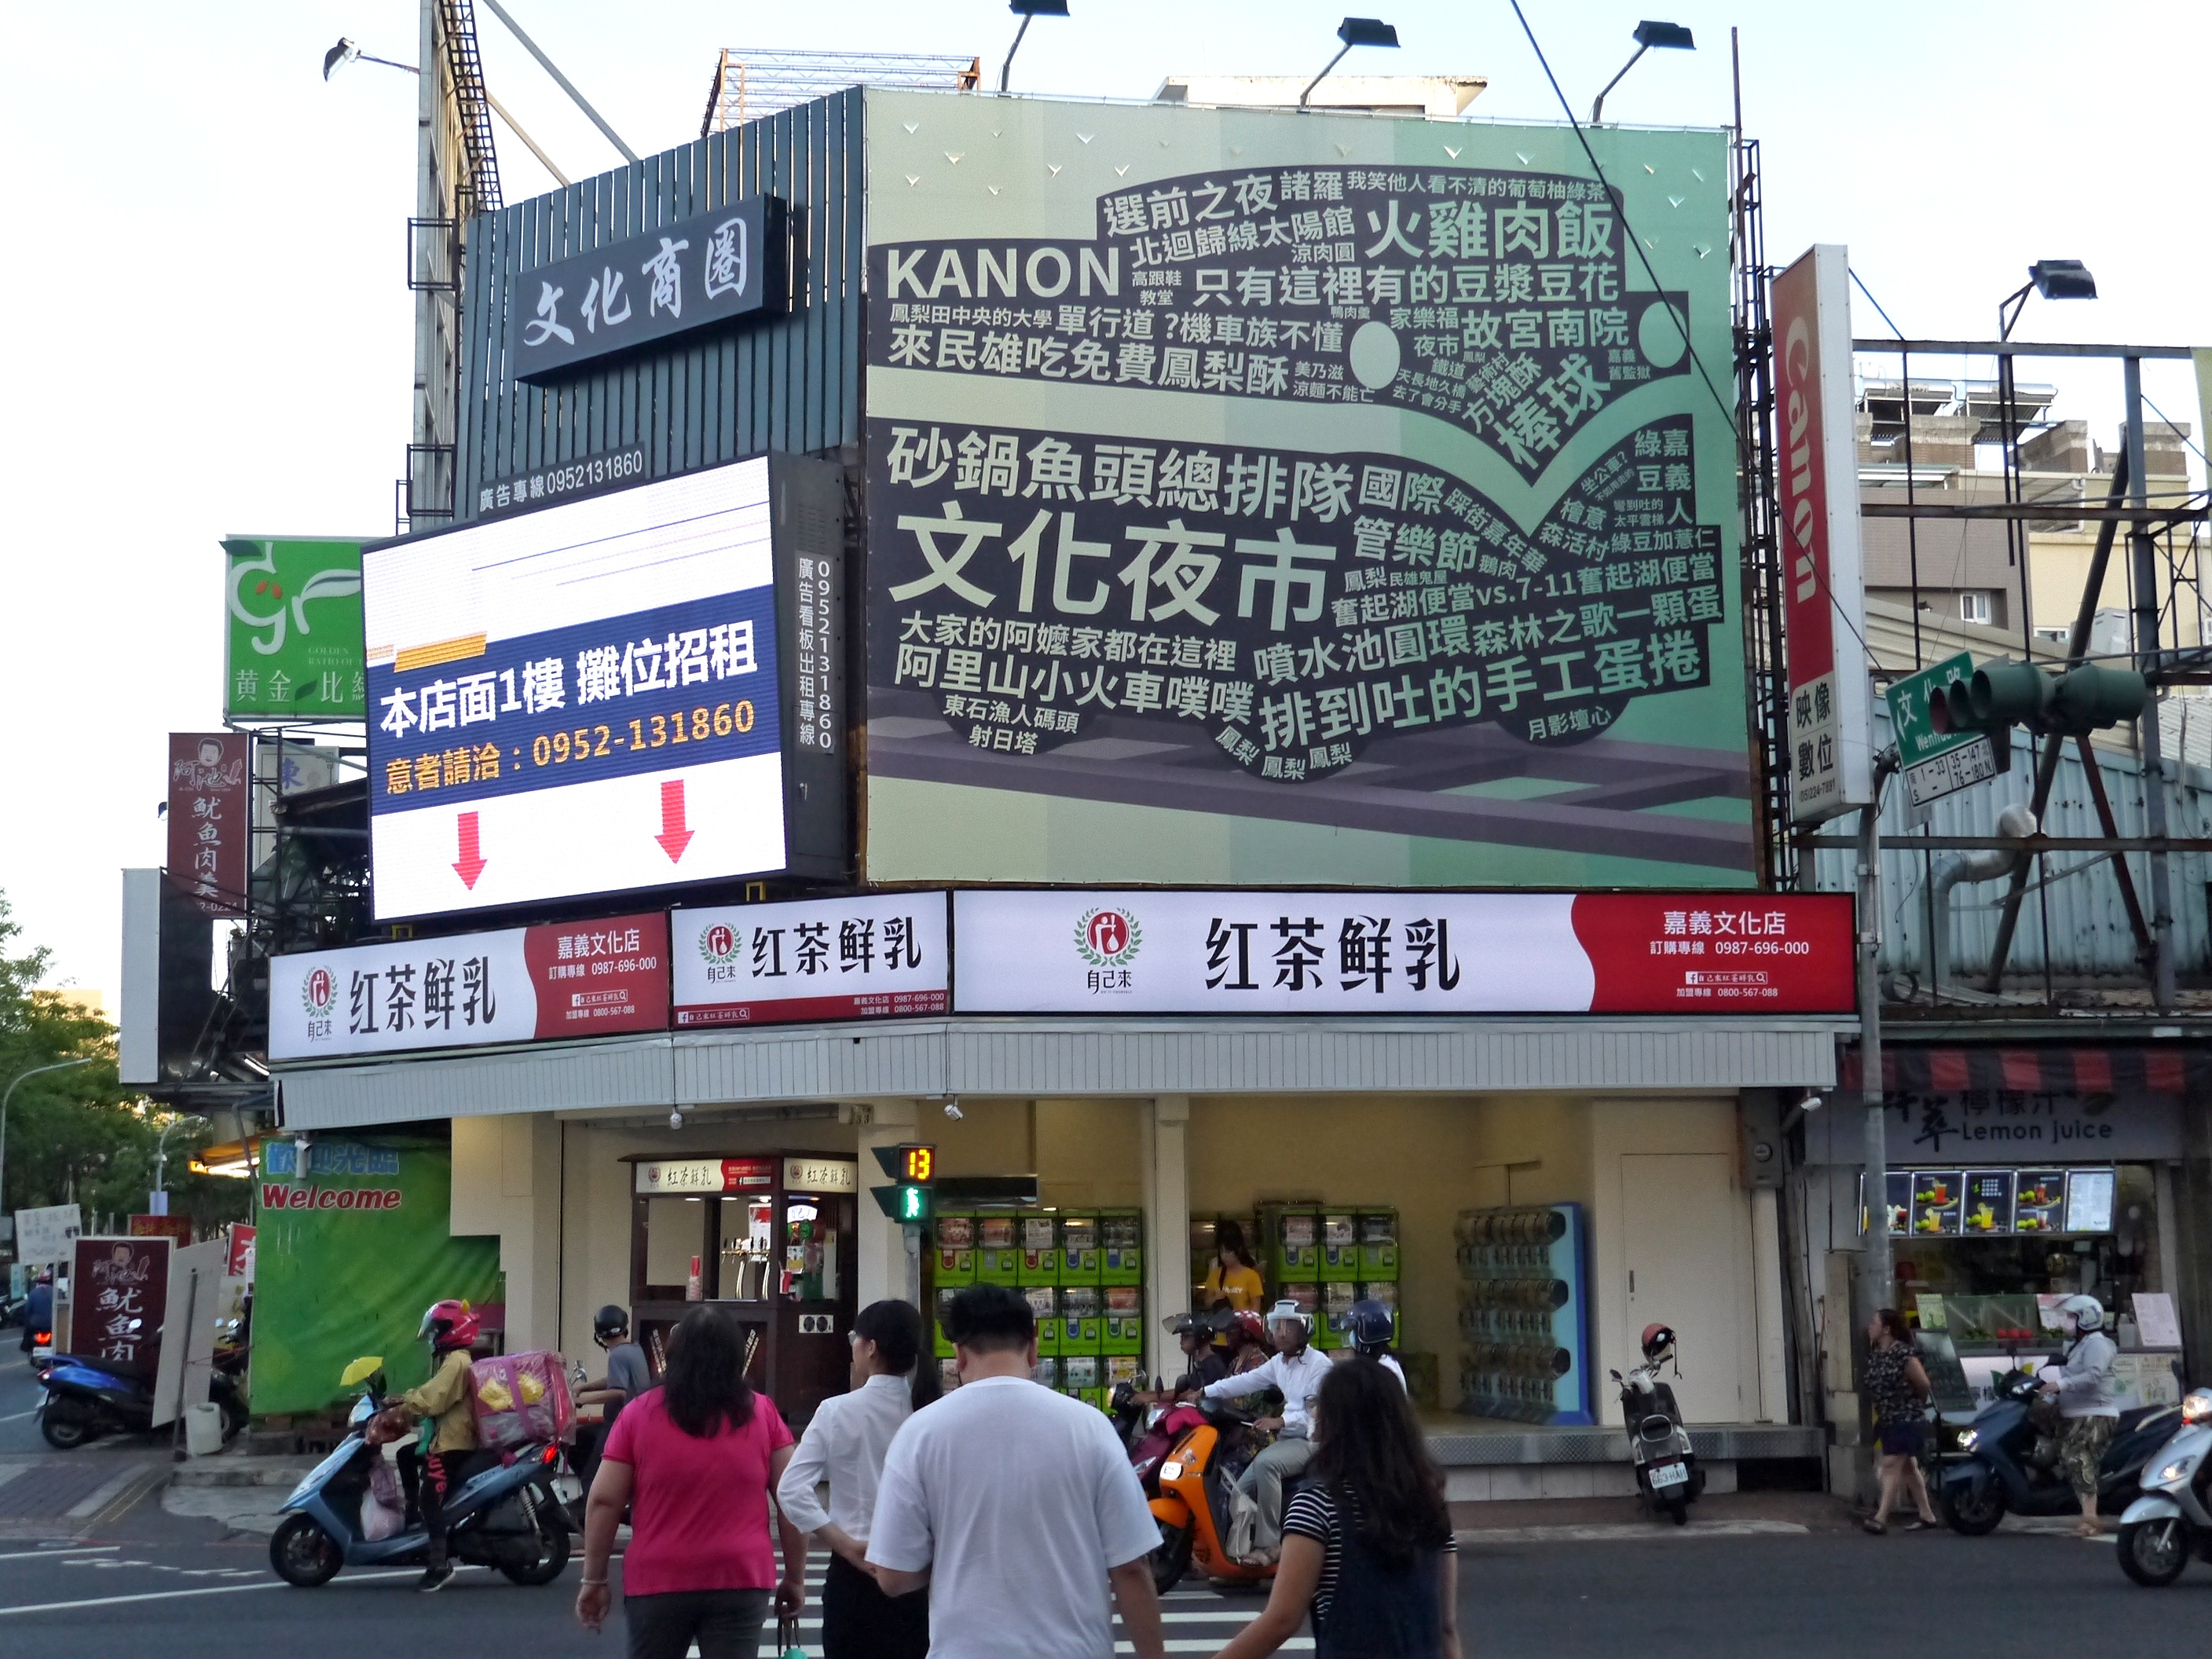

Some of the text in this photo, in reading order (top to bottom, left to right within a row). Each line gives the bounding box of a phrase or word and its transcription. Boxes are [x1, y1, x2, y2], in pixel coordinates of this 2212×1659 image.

[1280, 171, 1343, 200] 諸羅
[1347, 171, 1606, 202] 我笑他人看不清的葡萄柚綠茶
[1104, 174, 1278, 237] 選前之夜
[1130, 206, 1355, 269] 北迴歸線太陽館
[1364, 200, 1615, 259] 火雞肉飯
[1291, 243, 1355, 263] 涼肉圓
[523, 218, 747, 346] 文化商圈
[888, 247, 1119, 298] KANON
[1131, 270, 1181, 287] 高跟鞋
[1193, 262, 1618, 306] 只有這裡有的豆漿豆花
[1140, 290, 1174, 306] 教堂
[890, 303, 1052, 328] 鳳梨田中央的大學
[1390, 306, 1459, 330] 家樂福
[1462, 306, 1628, 350] 故宮南院
[888, 324, 1288, 396] 來民雄吃免費鳳梨酥
[1414, 335, 1459, 357] 夜市
[1295, 361, 1344, 381] 美乃滋
[1397, 368, 1467, 399] 天長地久橋
[1431, 357, 1466, 381] 鐵道
[1466, 352, 1511, 395] 藝術村
[1393, 385, 1463, 414] 去了會分手
[1462, 352, 1542, 434] 方塊酥
[1493, 353, 1610, 471] 棒球
[887, 427, 1354, 523] 砂鍋魚頭總排隊
[1785, 317, 1817, 603] Canon
[1359, 464, 1445, 516] 國際
[1353, 515, 1480, 574] 管樂節
[1444, 488, 1548, 574] 踩街嘉年華
[1539, 522, 1610, 563] 森活村
[888, 501, 1338, 632] 文化夜市
[1344, 566, 1387, 593] 鳳梨
[1389, 569, 1448, 587] 民雄鬼屋
[1478, 555, 1518, 580] 鵝肉
[799, 558, 815, 745] 廣告看板出租專線
[818, 561, 832, 749] 0952131860
[899, 610, 1238, 673] 大家的阿嬤家都在這裡
[380, 620, 758, 738] 本店面1樓 攤位招租
[895, 644, 1254, 727] 阿里山小火車噗噗
[1259, 628, 1701, 752] 排到吐的手工蛋捲
[943, 694, 1080, 735] 東石漁人碼頭
[1795, 682, 1831, 728] 映像
[969, 724, 1038, 755] 射日塔
[1215, 725, 1260, 766] 鳳梨
[1309, 742, 1353, 769] 鳳梨
[1261, 755, 1306, 780] 鳳梨
[1798, 733, 1833, 782] 數位
[1664, 911, 1785, 936] 嘉義文化店
[558, 928, 640, 960] 嘉義文化店
[1650, 940, 1809, 955] 訂購專線 0987-696-000
[548, 957, 657, 980] 訂購專線 0987-696-000
[854, 993, 944, 1005] 嘉義文化店 0987-696-000
[894, 1003, 944, 1013] 0800-567-088
[1676, 987, 1778, 998] 加盟專線 0800-567-088
[593, 1005, 635, 1017] 0800-567-088
[1963, 1122, 2042, 1141] Lemon
[909, 1149, 930, 1180] 13
[262, 1183, 401, 1210] Welcome
